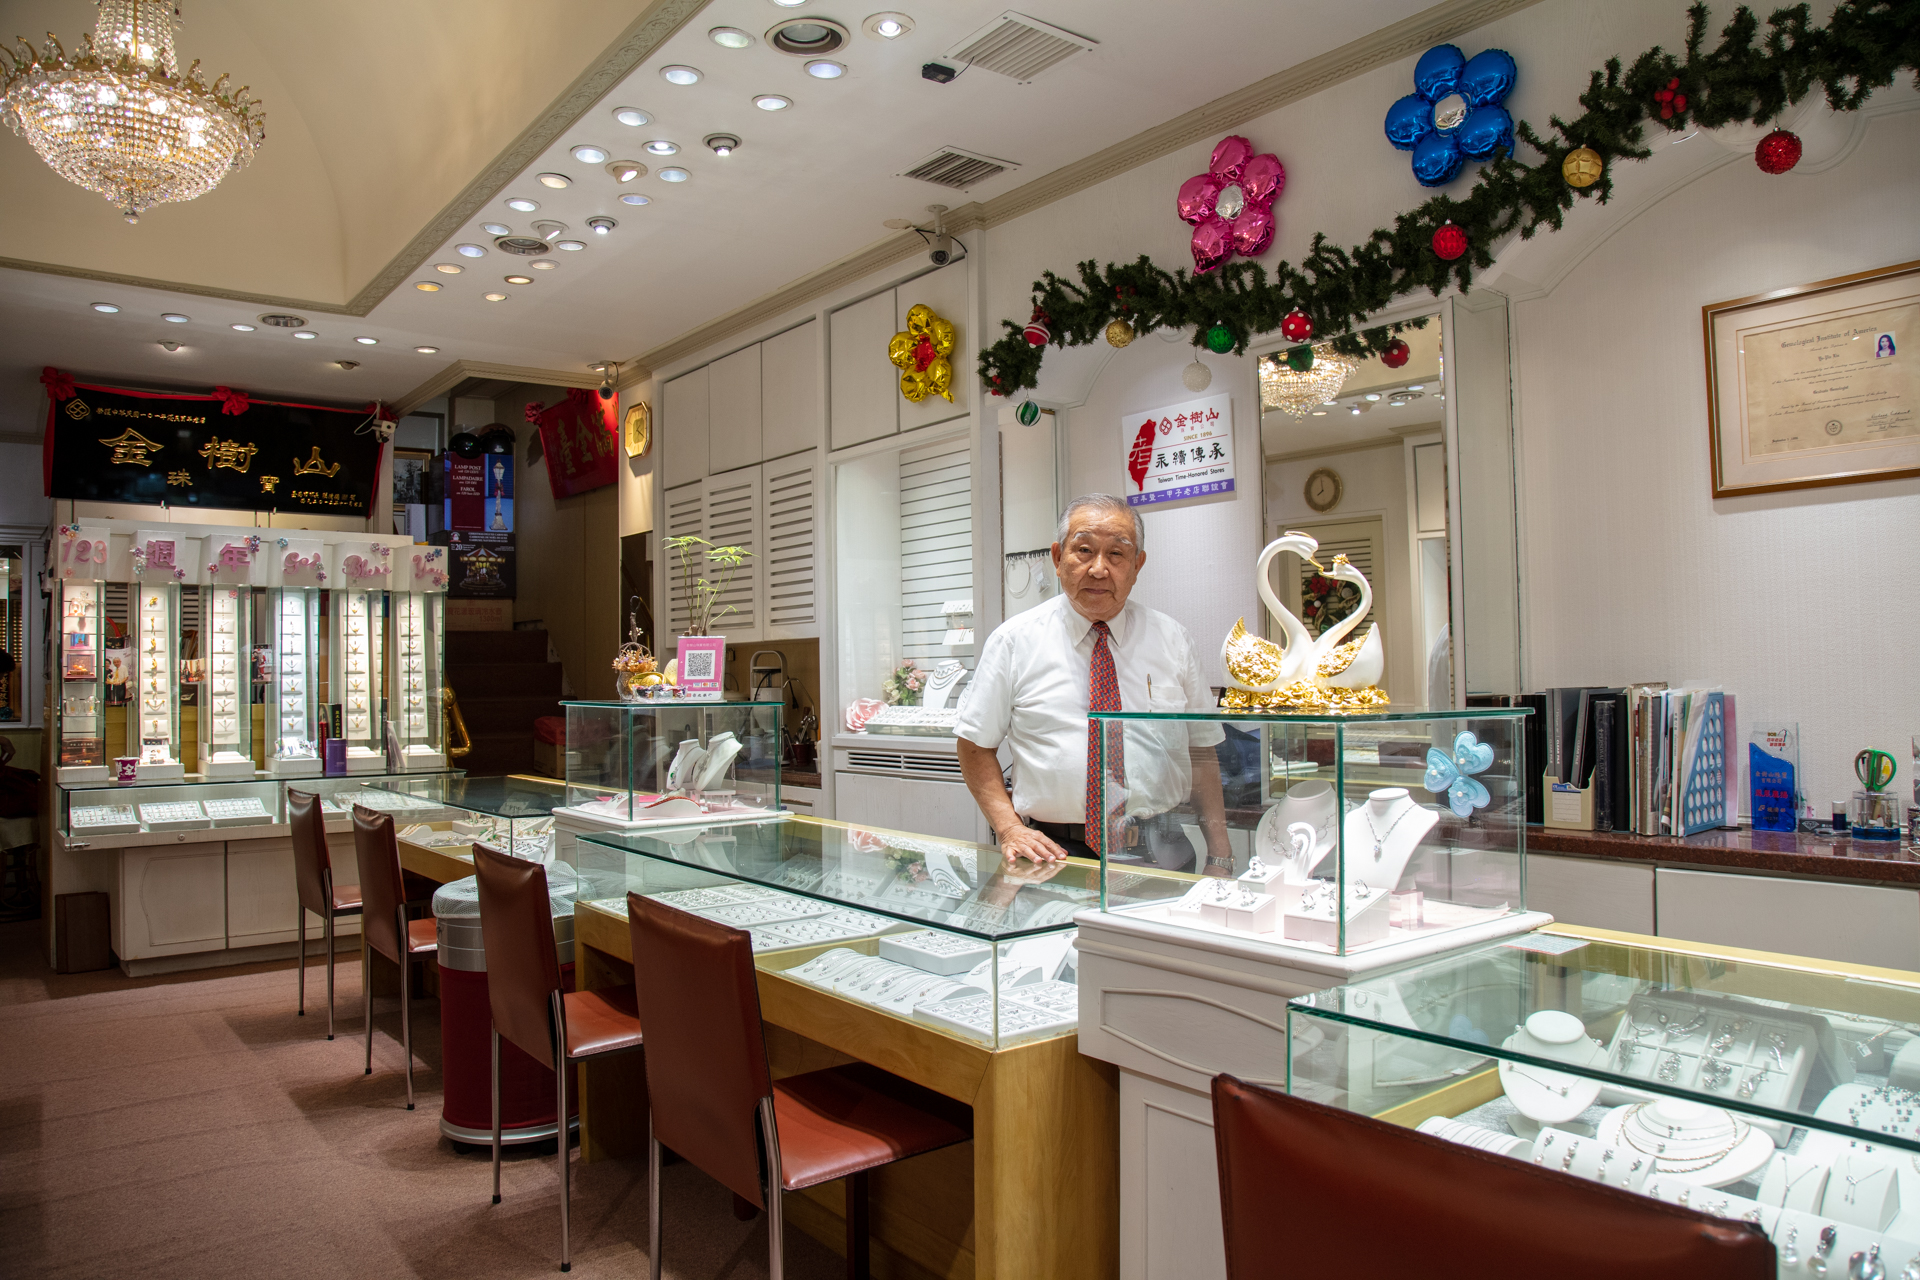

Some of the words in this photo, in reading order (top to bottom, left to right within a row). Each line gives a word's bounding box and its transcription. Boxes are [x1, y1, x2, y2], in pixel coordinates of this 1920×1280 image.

[1781, 338, 1814, 349] Gemological
[1817, 333, 1842, 343] Institute
[1853, 326, 1877, 335] America
[1174, 407, 1220, 429] 金樹山
[1183, 433, 1198, 441] SINCE
[98, 427, 342, 479] 金樹山
[1155, 442, 1226, 469] 永續傳承
[167, 468, 281, 495] 珠寶
[1157, 475, 1174, 483] Taiwan
[1175, 469, 1208, 480] Time-Honored
[1210, 467, 1225, 475] Stores
[62, 539, 108, 564] 123
[145, 540, 177, 570] 週
[218, 543, 251, 573] 年
[455, 543, 463, 551] 20
[283, 551, 322, 575] God
[342, 554, 393, 579] Bless
[412, 554, 444, 580] You
